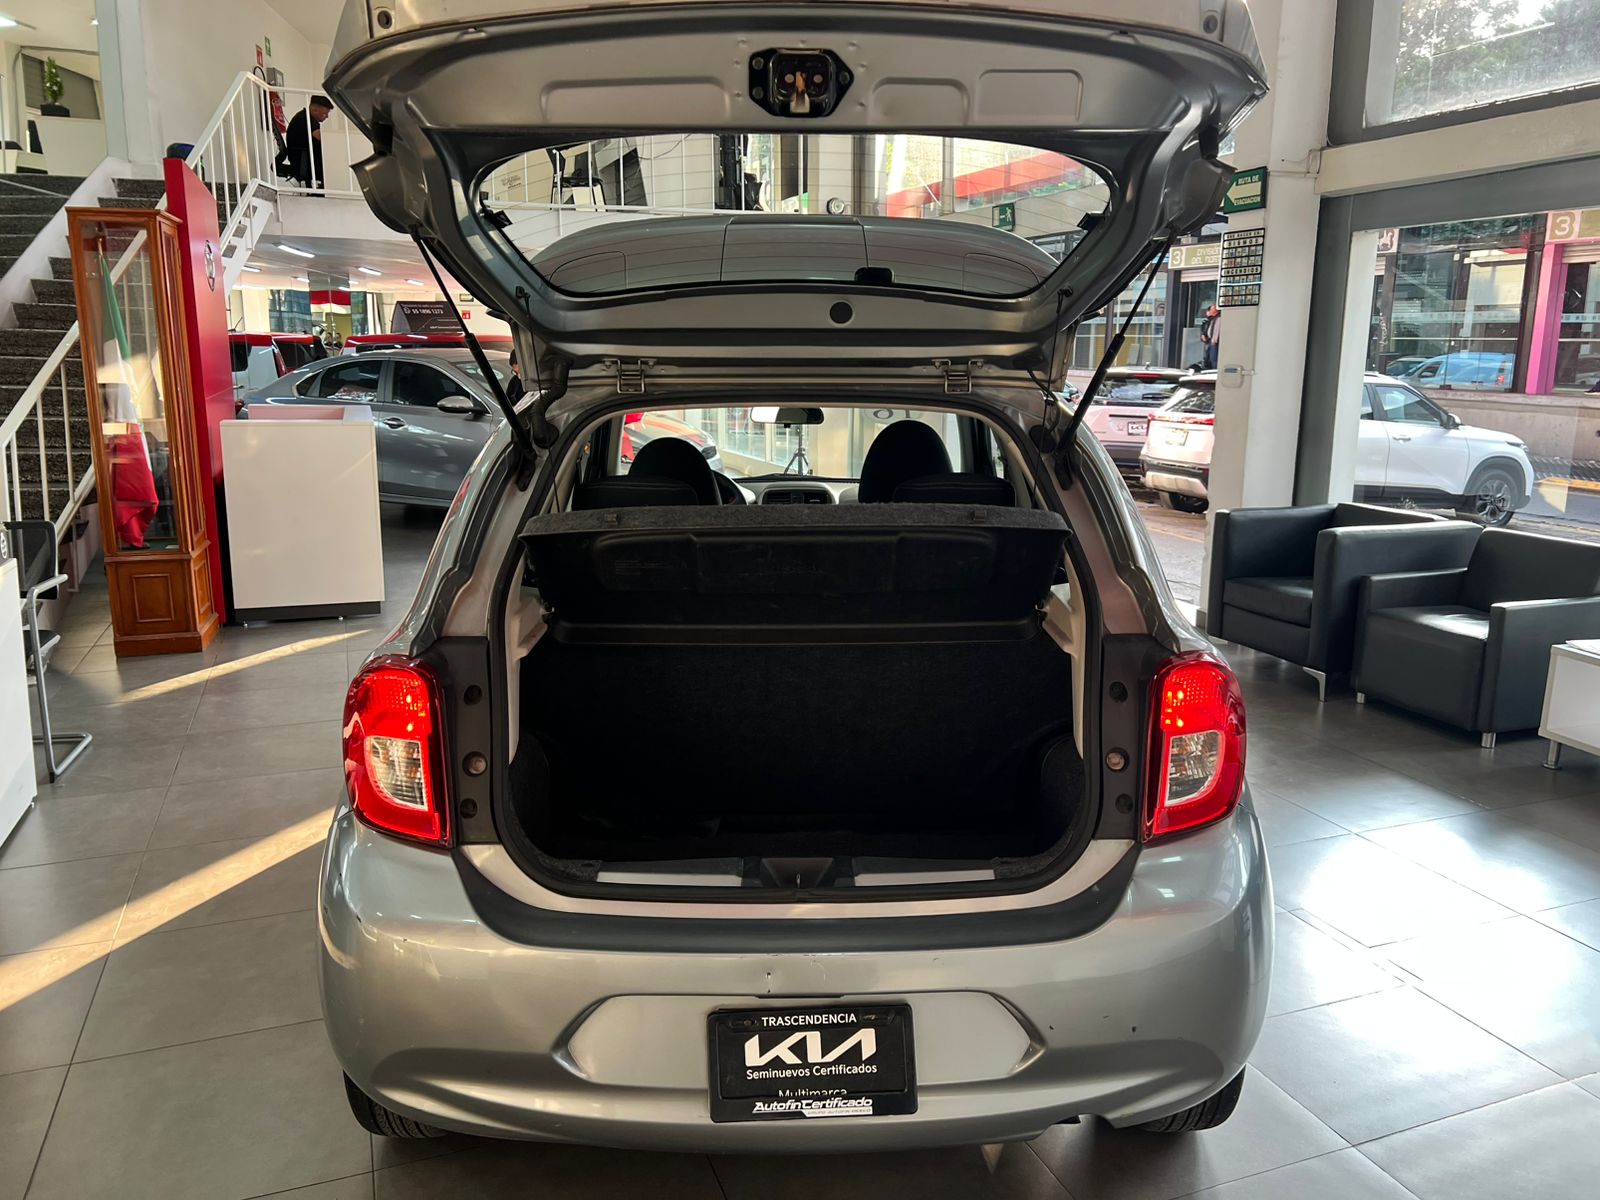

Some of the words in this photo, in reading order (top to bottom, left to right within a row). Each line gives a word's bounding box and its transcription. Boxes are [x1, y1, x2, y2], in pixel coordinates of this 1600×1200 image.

[1555, 216, 1570, 235] 3
[1172, 250, 1181, 265] 3
[1223, 266, 1260, 275] INCENDIOS
[761, 1013, 857, 1028] TRASCENDENCIA
[744, 1028, 877, 1068] KIA
[746, 1067, 810, 1080] Seminuevos
[812, 1063, 878, 1076] Certificados
